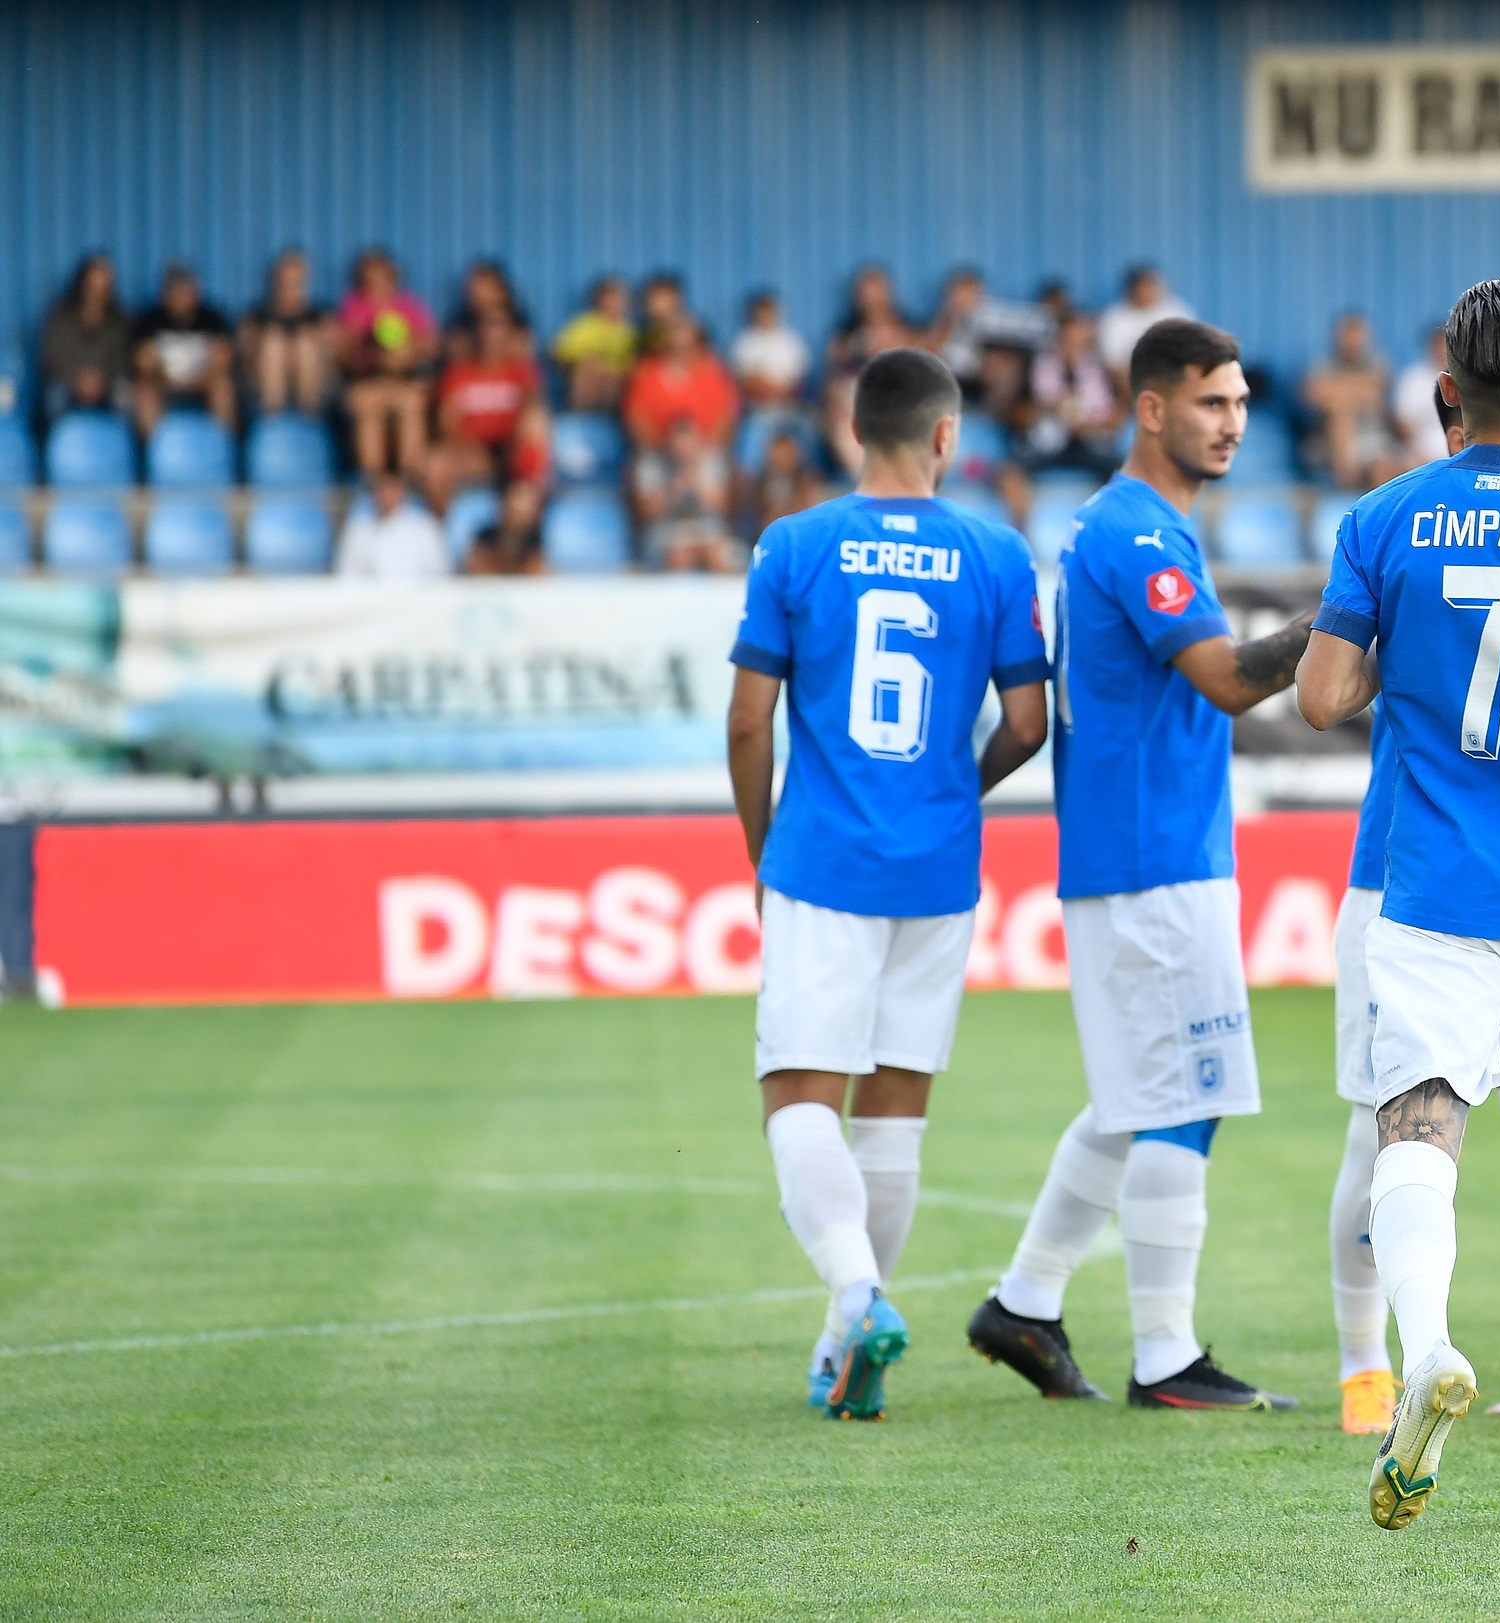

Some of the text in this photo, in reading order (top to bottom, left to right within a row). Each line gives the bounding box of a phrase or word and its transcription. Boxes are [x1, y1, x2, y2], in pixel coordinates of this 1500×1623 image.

[1268, 68, 1384, 162] NU
[839, 539, 961, 583] SCRECIU
[264, 648, 697, 722] CARPATINA
[848, 587, 939, 763] 6
